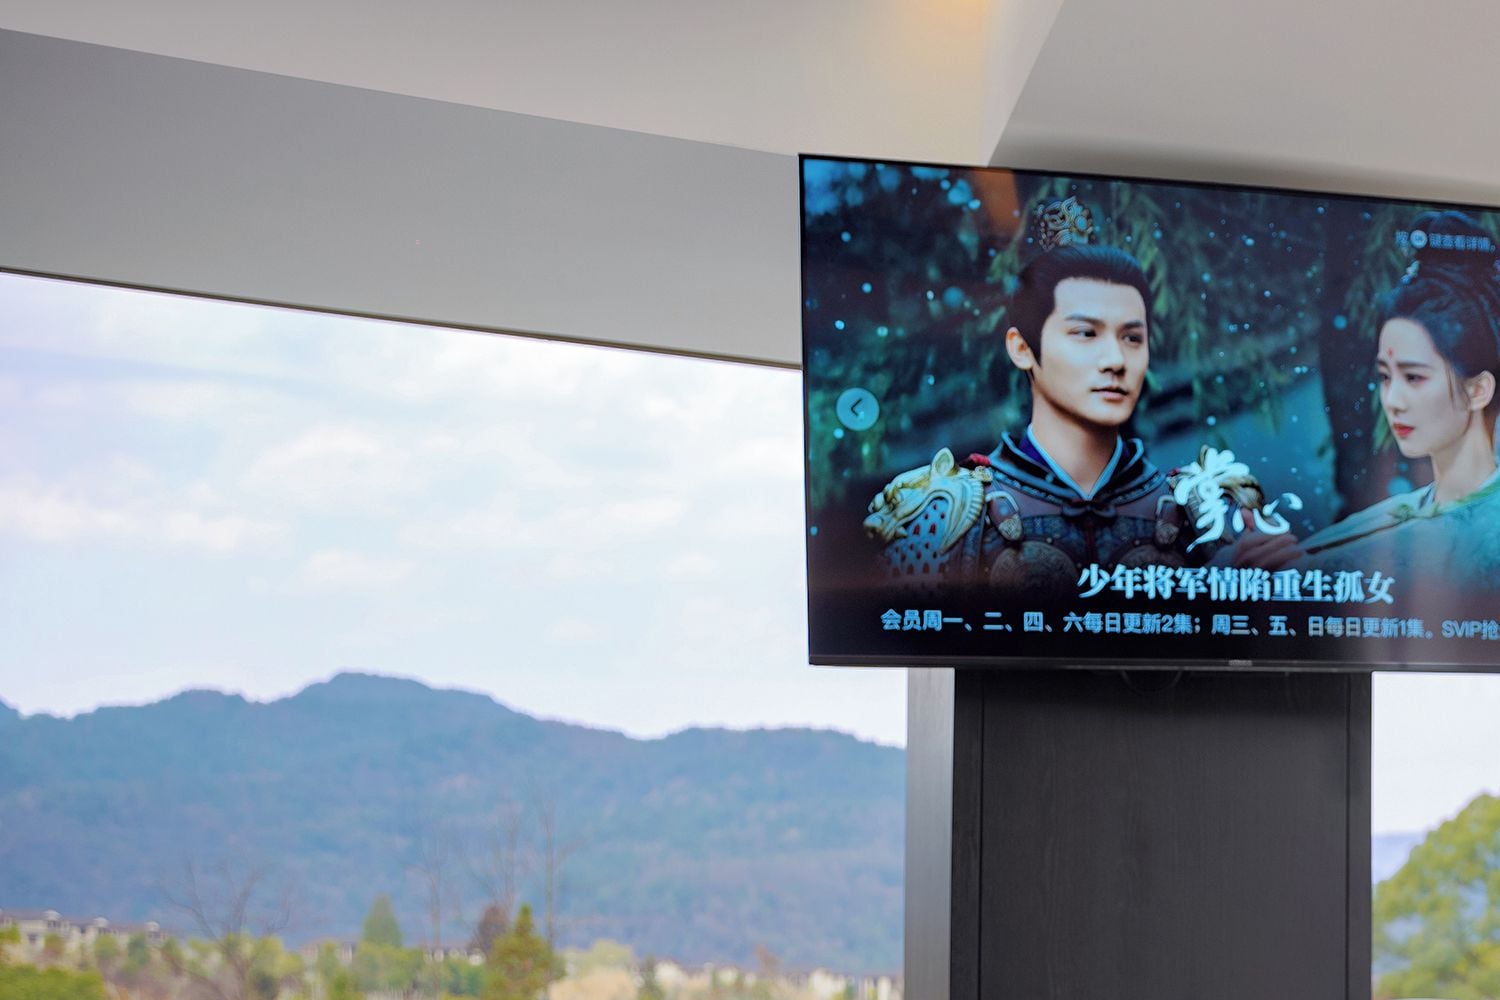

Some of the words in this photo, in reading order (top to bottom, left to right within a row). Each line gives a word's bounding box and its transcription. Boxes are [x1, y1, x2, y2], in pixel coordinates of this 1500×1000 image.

[1076, 562, 1396, 604] 少年将军情陷重生孤女
